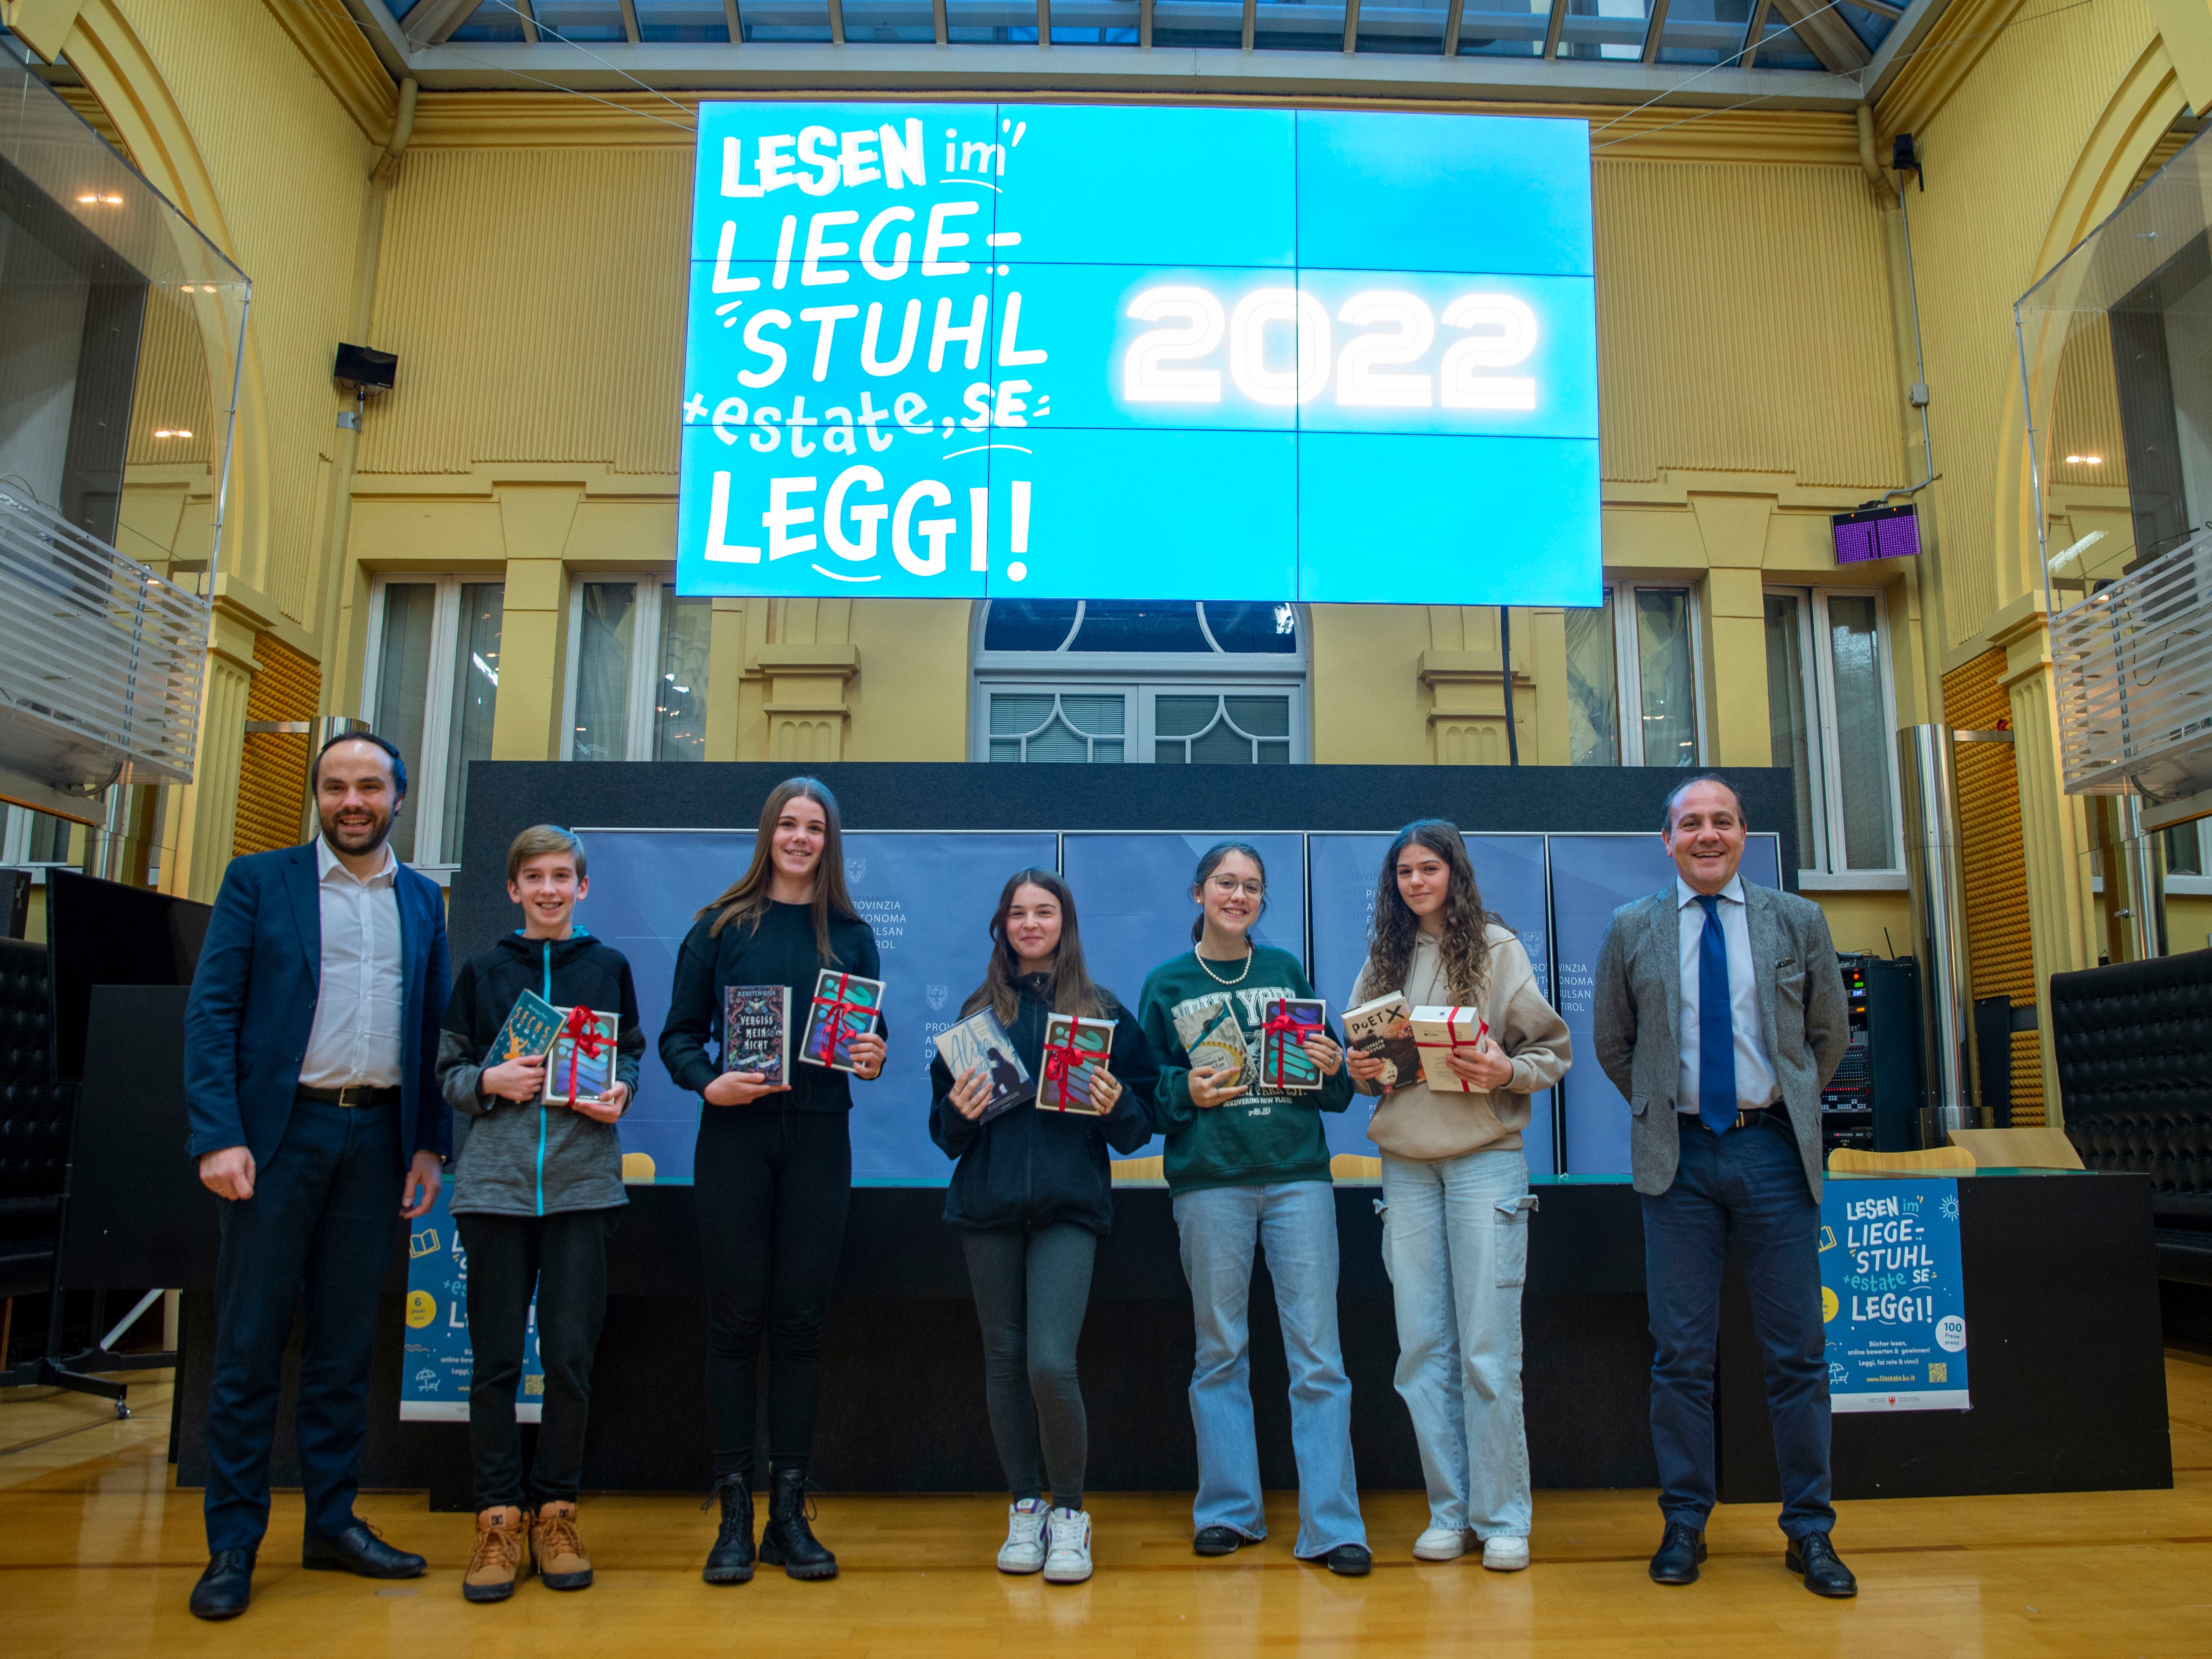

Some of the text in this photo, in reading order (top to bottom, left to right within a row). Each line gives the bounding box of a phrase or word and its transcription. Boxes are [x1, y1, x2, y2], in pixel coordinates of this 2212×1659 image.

[720, 118, 1005, 196] LESEN im
[711, 201, 1022, 293] LIEGE-
[737, 291, 1048, 388] STUHL
[1124, 286, 1538, 410] 2022
[705, 466, 1031, 582] LEGGI!
[852, 901, 901, 910] ROVINZIA
[861, 914, 906, 923] TONOMA
[873, 927, 903, 936] LSAN
[1385, 1005, 1405, 1023] X
[1561, 1002, 1585, 1011] TIROL
[740, 1015, 773, 1026] VERGISS
[746, 1027, 766, 1039] MEIN
[744, 1039, 768, 1051] NICHT
[950, 1028, 992, 1074] Alice
[1369, 1043, 1385, 1053] EVEDO
[1223, 1097, 1259, 1107] DISCOVERING
[1847, 1196, 1919, 1220] LESEN im
[1847, 1219, 1925, 1248] LIEGE-
[1856, 1244, 1934, 1274] STUHL
[1913, 1268, 1930, 1284] SE
[1852, 1293, 1932, 1323] LEGGI!
[1944, 1322, 1962, 1332] 100
[1901, 1347, 1930, 1356] gewinnen!
